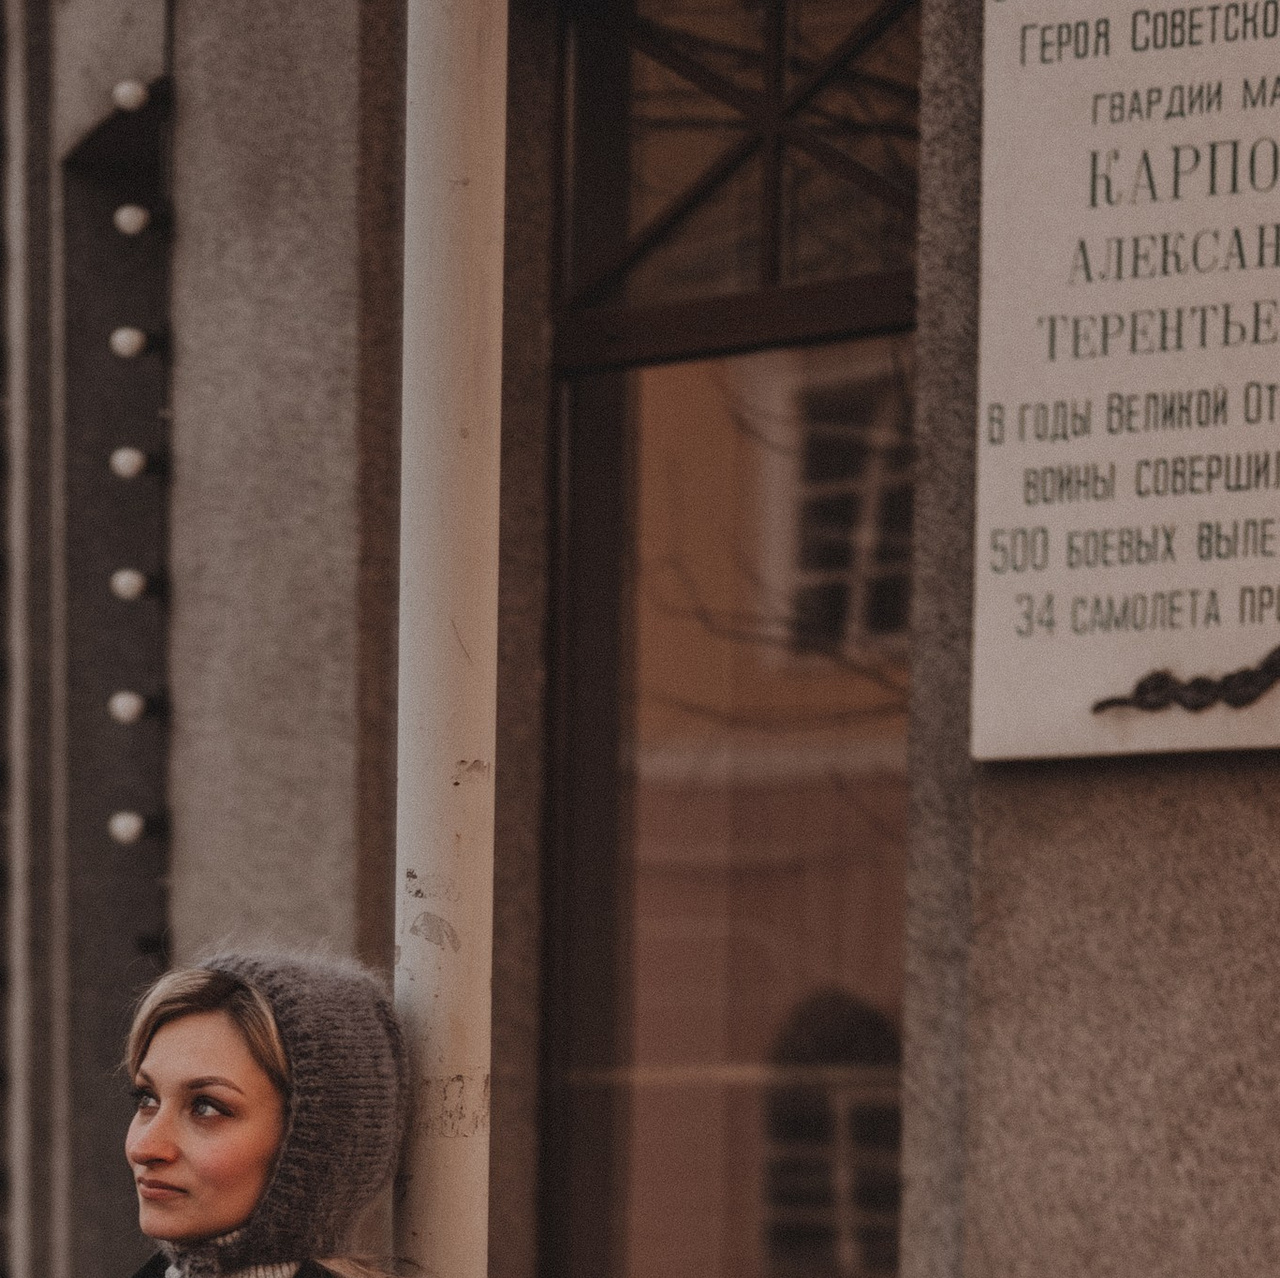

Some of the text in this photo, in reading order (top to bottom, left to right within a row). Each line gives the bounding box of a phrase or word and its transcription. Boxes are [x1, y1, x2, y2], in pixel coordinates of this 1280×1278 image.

[1019, 0, 1279, 67] ГЕРОЯ СОВЕТСКО
[1091, 81, 1222, 125] ГВАРДИИ
[1089, 136, 1279, 208] КАРПО
[1068, 222, 1280, 284] АЛЕКСАН
[1037, 300, 1278, 361] ТЕРЕНТЬЕ
[986, 401, 1006, 445] В
[1020, 400, 1092, 443] ГОДЫ
[1244, 381, 1278, 425] ОТ
[989, 517, 1276, 575] 500 БОЕВЫХ ВЫЛЕ
[1015, 591, 1055, 639] 34
[1239, 585, 1280, 626] ПР
